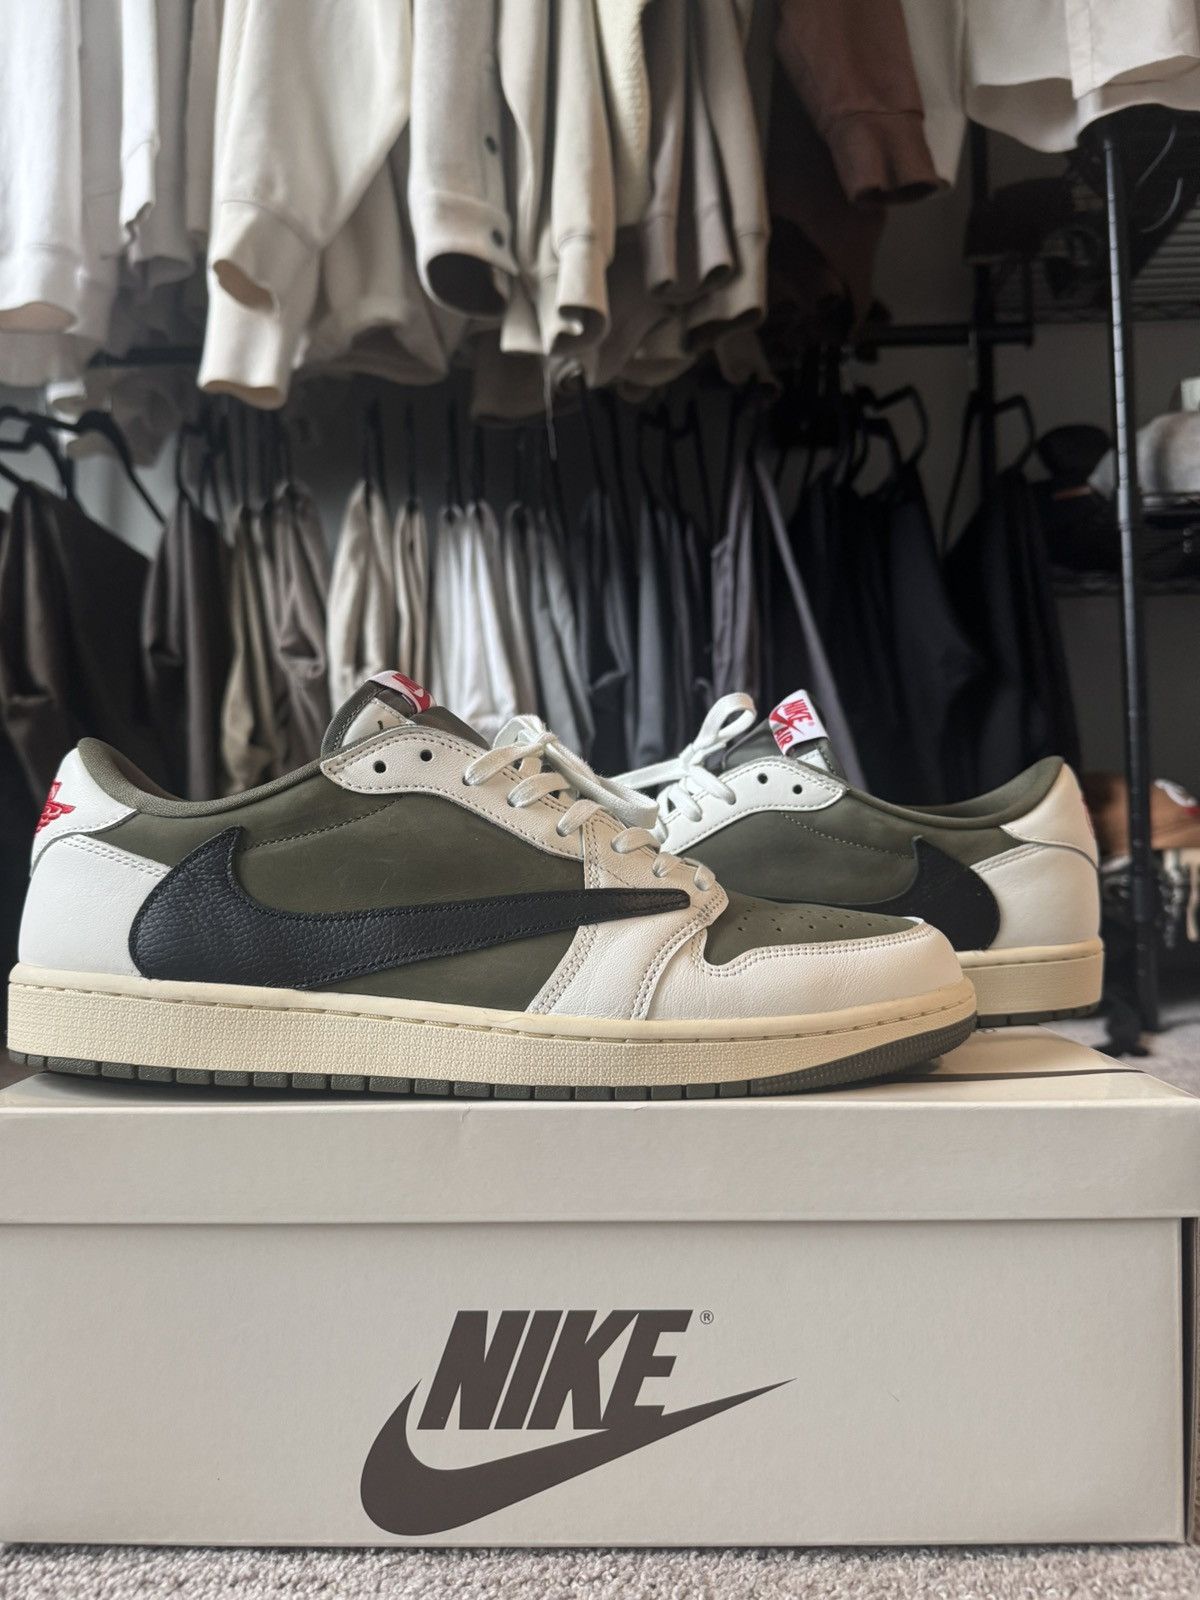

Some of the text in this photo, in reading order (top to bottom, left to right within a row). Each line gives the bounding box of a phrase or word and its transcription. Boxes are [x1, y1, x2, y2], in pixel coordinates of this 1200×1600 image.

[783, 698, 813, 721] NIKE
[774, 726, 793, 749] AIR
[416, 1309, 694, 1430] NIKE
